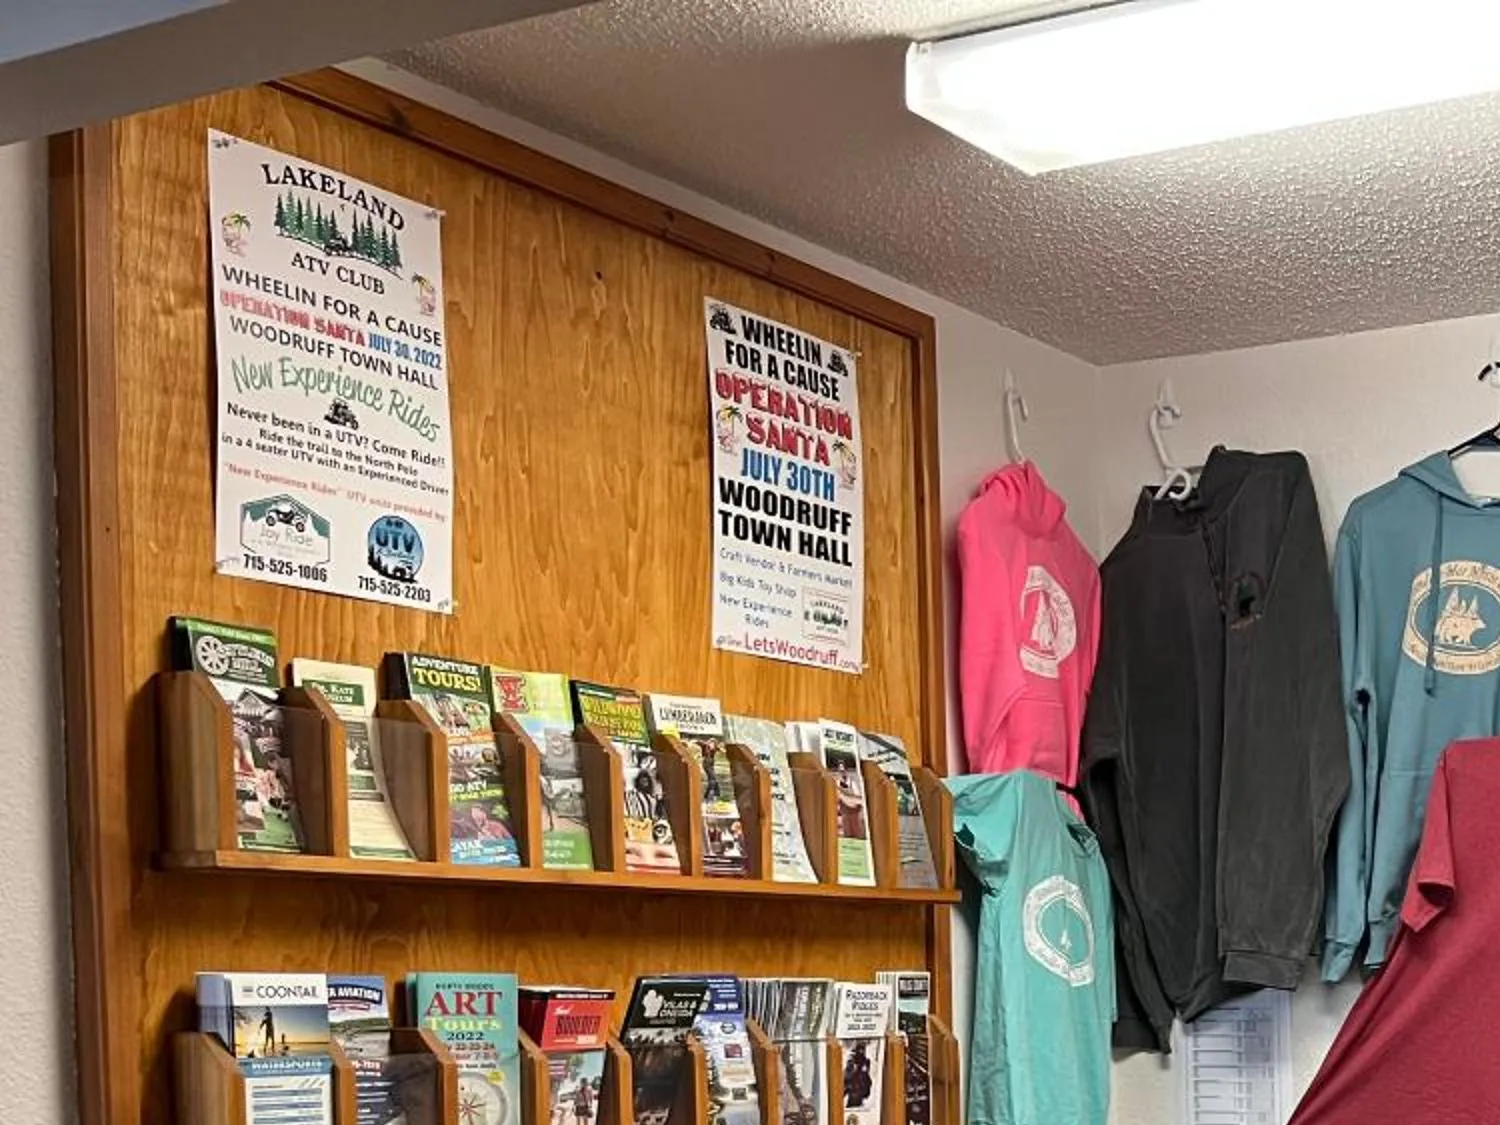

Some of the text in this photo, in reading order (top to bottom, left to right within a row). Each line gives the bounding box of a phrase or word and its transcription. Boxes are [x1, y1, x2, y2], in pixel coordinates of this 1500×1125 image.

[261, 163, 405, 231] LAKELAND
[291, 251, 386, 296] ATV CLUB
[222, 263, 443, 347] WHEELIN FOR A CAUSE
[219, 289, 312, 329] OPERATION
[315, 314, 366, 347] SANTA
[368, 331, 393, 357] JULY
[413, 345, 443, 371] 2022
[230, 315, 440, 391] WOODRUFF TOWN HALL
[741, 315, 823, 369] WHEELIN
[725, 339, 841, 402] FOR A CAUSE
[231, 353, 442, 442] New Experience Rides
[715, 368, 853, 440] OPERATION
[221, 432, 233, 445] in
[235, 438, 243, 447] a
[255, 440, 289, 457] seater
[291, 449, 313, 463] UTV
[316, 455, 341, 470] with
[227, 401, 268, 424] Never
[271, 411, 305, 433] been
[308, 420, 321, 437] in
[324, 428, 333, 440] a
[335, 427, 370, 448] UTV?
[372, 439, 408, 461] Come
[259, 428, 284, 444] Ride
[286, 433, 304, 449] the
[307, 440, 329, 454] trail
[331, 446, 343, 458] to
[345, 449, 363, 463] the
[365, 454, 396, 471] North
[745, 411, 831, 467] SANTA
[741, 447, 836, 502] JULY 30TH
[719, 477, 853, 537] WOODRUFF
[285, 527, 314, 548] Ride
[375, 528, 417, 554] UTV
[718, 509, 853, 567] TOWN HALL
[243, 553, 328, 583] 715-525-1006
[358, 575, 432, 603] 715-525-2203
[411, 655, 479, 675] ADVENTURE
[413, 667, 481, 692] TOURS!
[337, 987, 382, 1002] AVIATION
[425, 991, 503, 1017] ART
[425, 1017, 502, 1031] Tours
[447, 1031, 485, 1041] 2022
